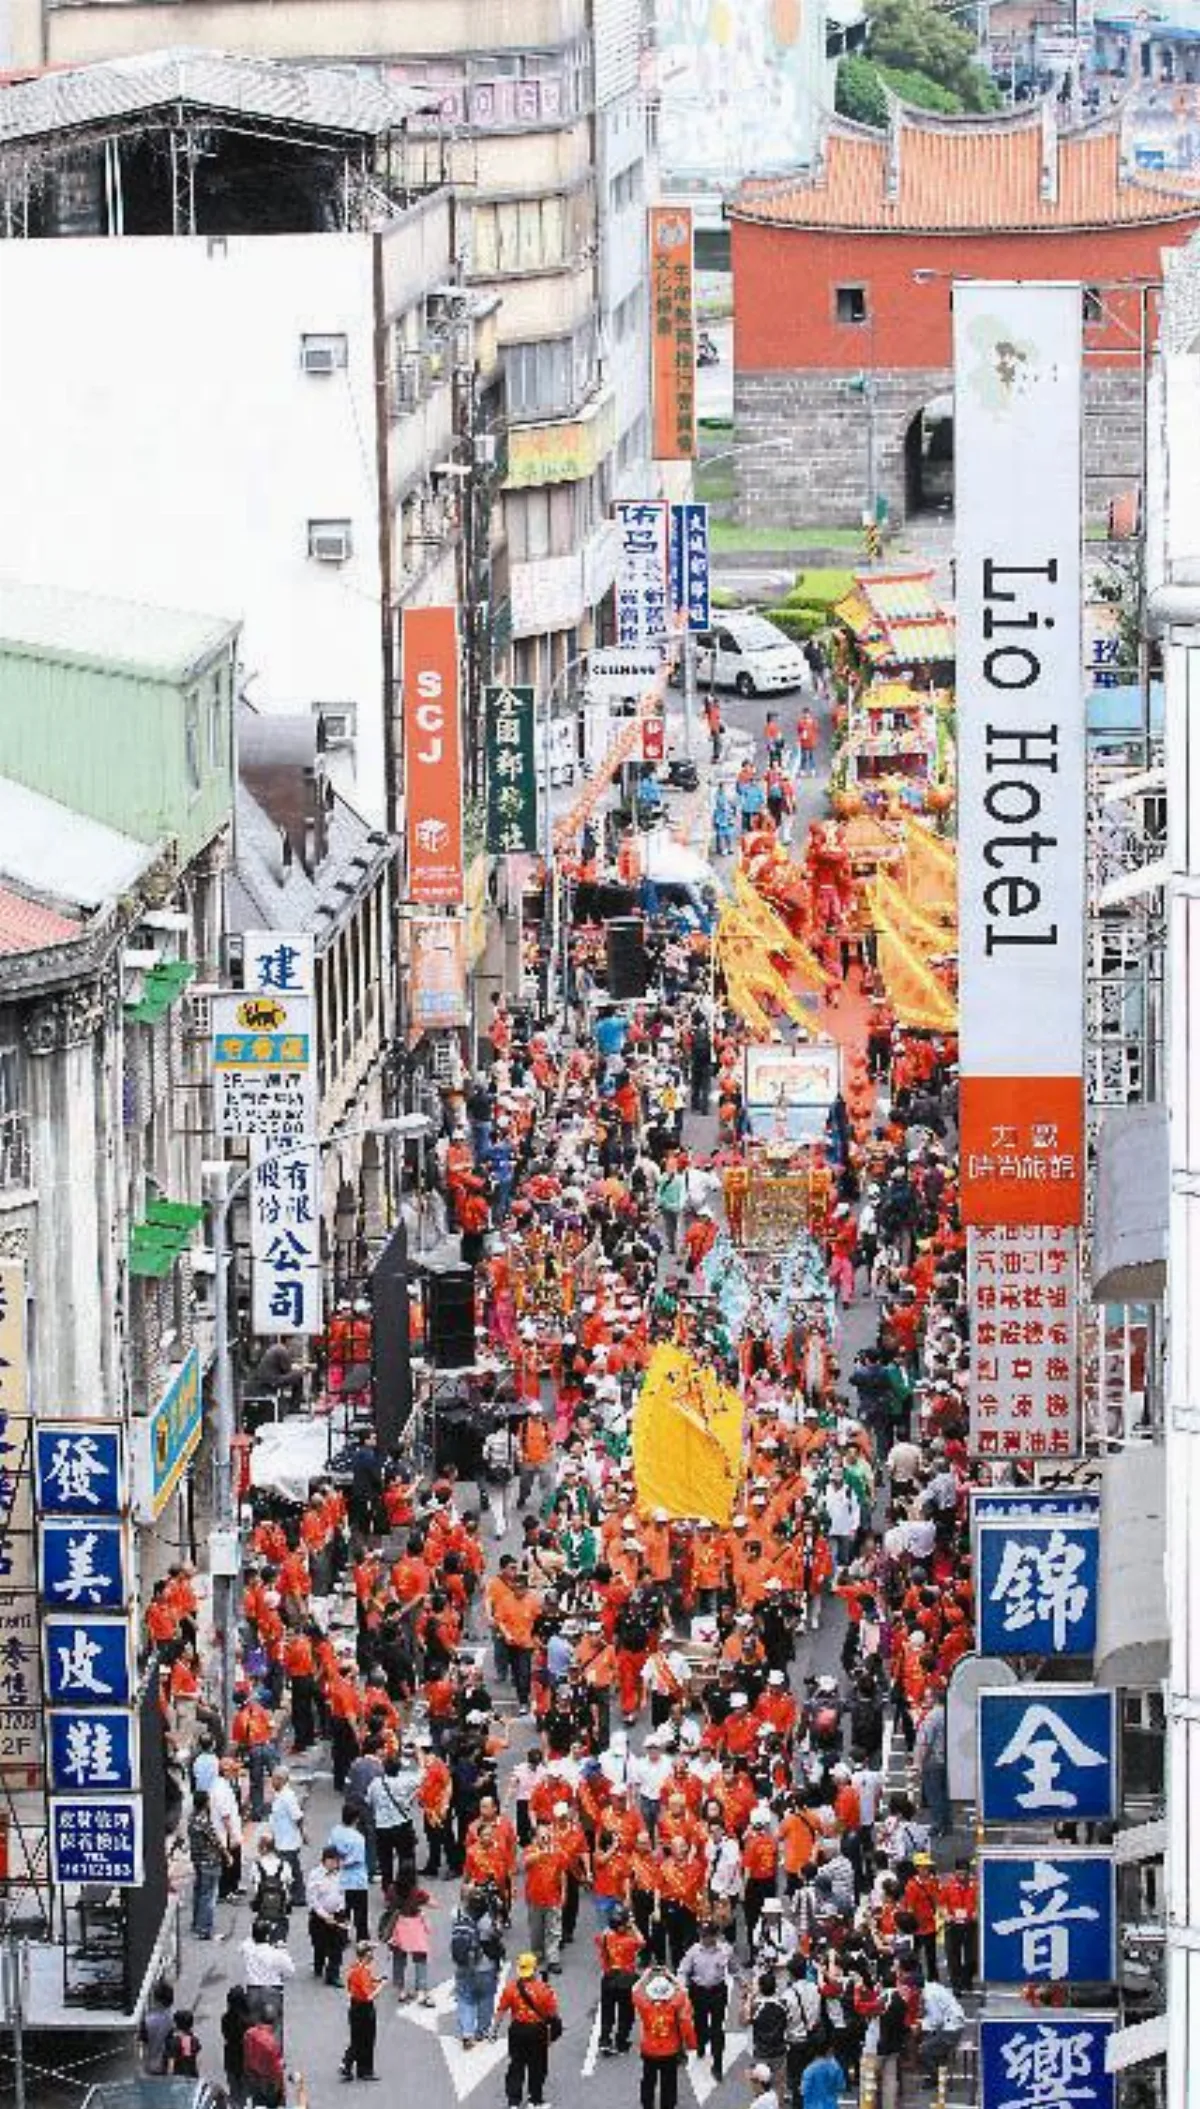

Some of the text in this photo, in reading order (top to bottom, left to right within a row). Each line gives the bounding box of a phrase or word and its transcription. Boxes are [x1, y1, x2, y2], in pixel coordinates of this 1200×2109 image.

[416, 671, 444, 763] SCJ
[983, 558, 1058, 956] Lio Hotel
[255, 943, 304, 990] 建
[257, 1157, 282, 1224] 股份
[266, 1228, 312, 1328] 公司
[83, 1852, 109, 1862] TEL
